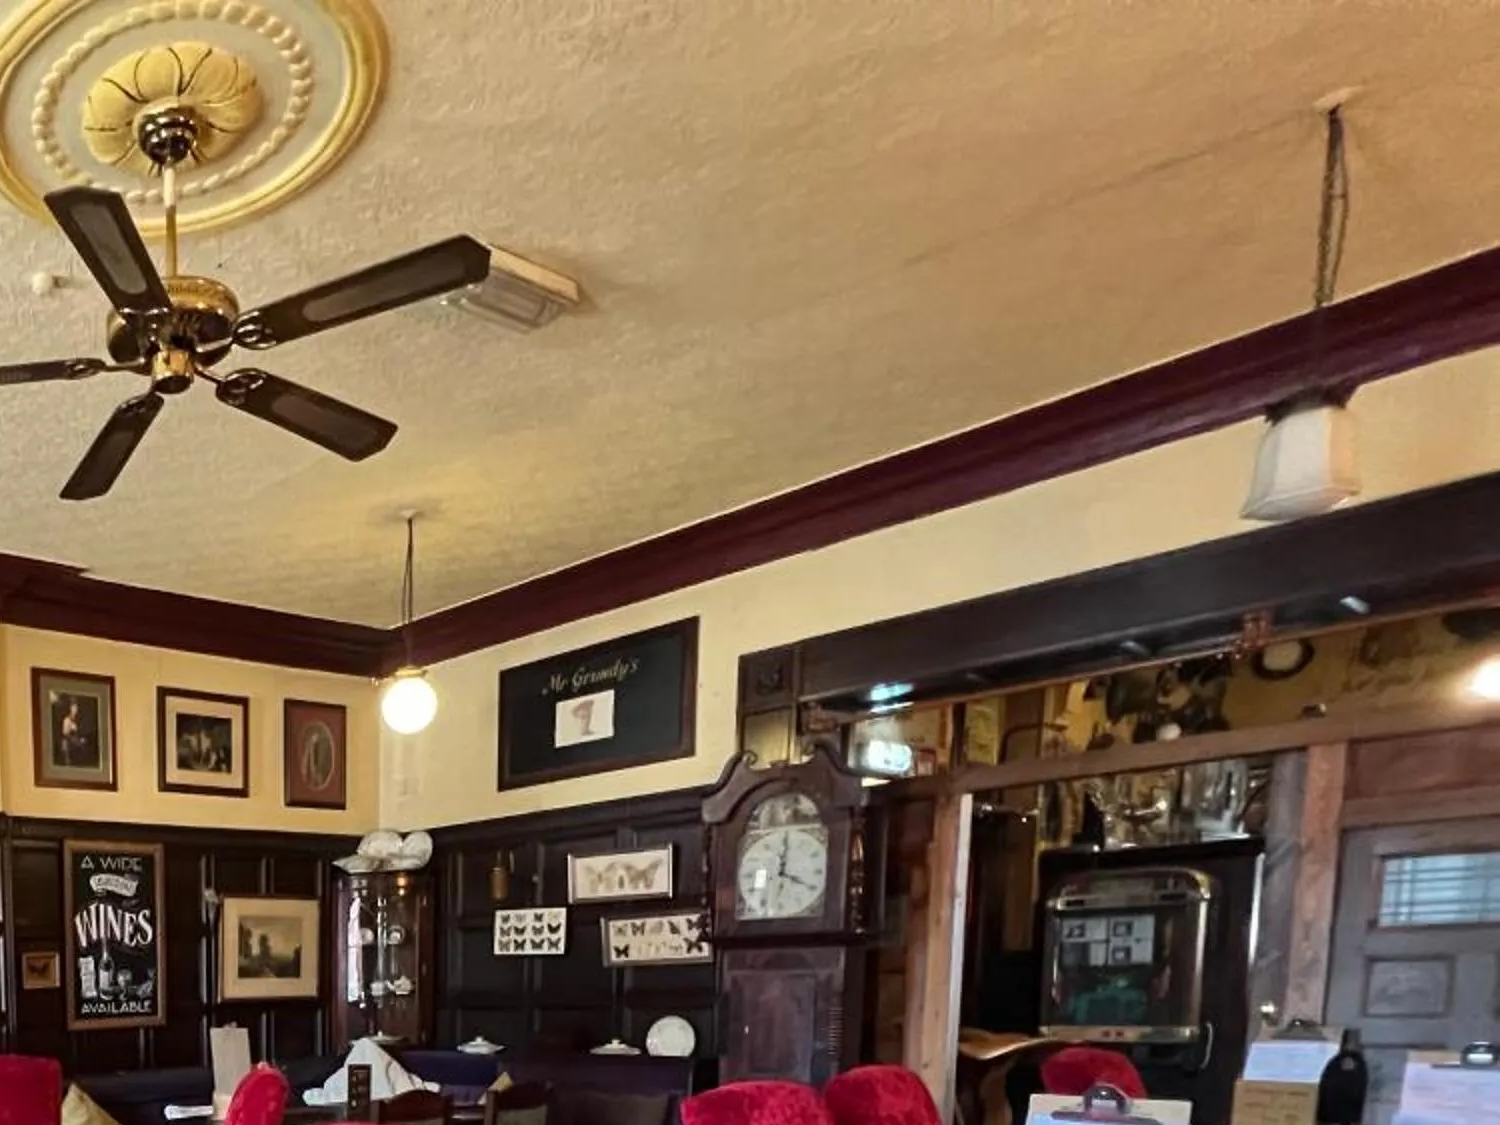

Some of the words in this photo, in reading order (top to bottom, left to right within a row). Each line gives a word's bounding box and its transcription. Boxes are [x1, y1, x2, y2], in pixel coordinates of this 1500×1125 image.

[572, 657, 640, 692] Grundy's
[80, 855, 94, 870] A
[100, 857, 143, 872] WIDE
[74, 903, 153, 948] WINES
[81, 1001, 151, 1014] AVAILABLE
